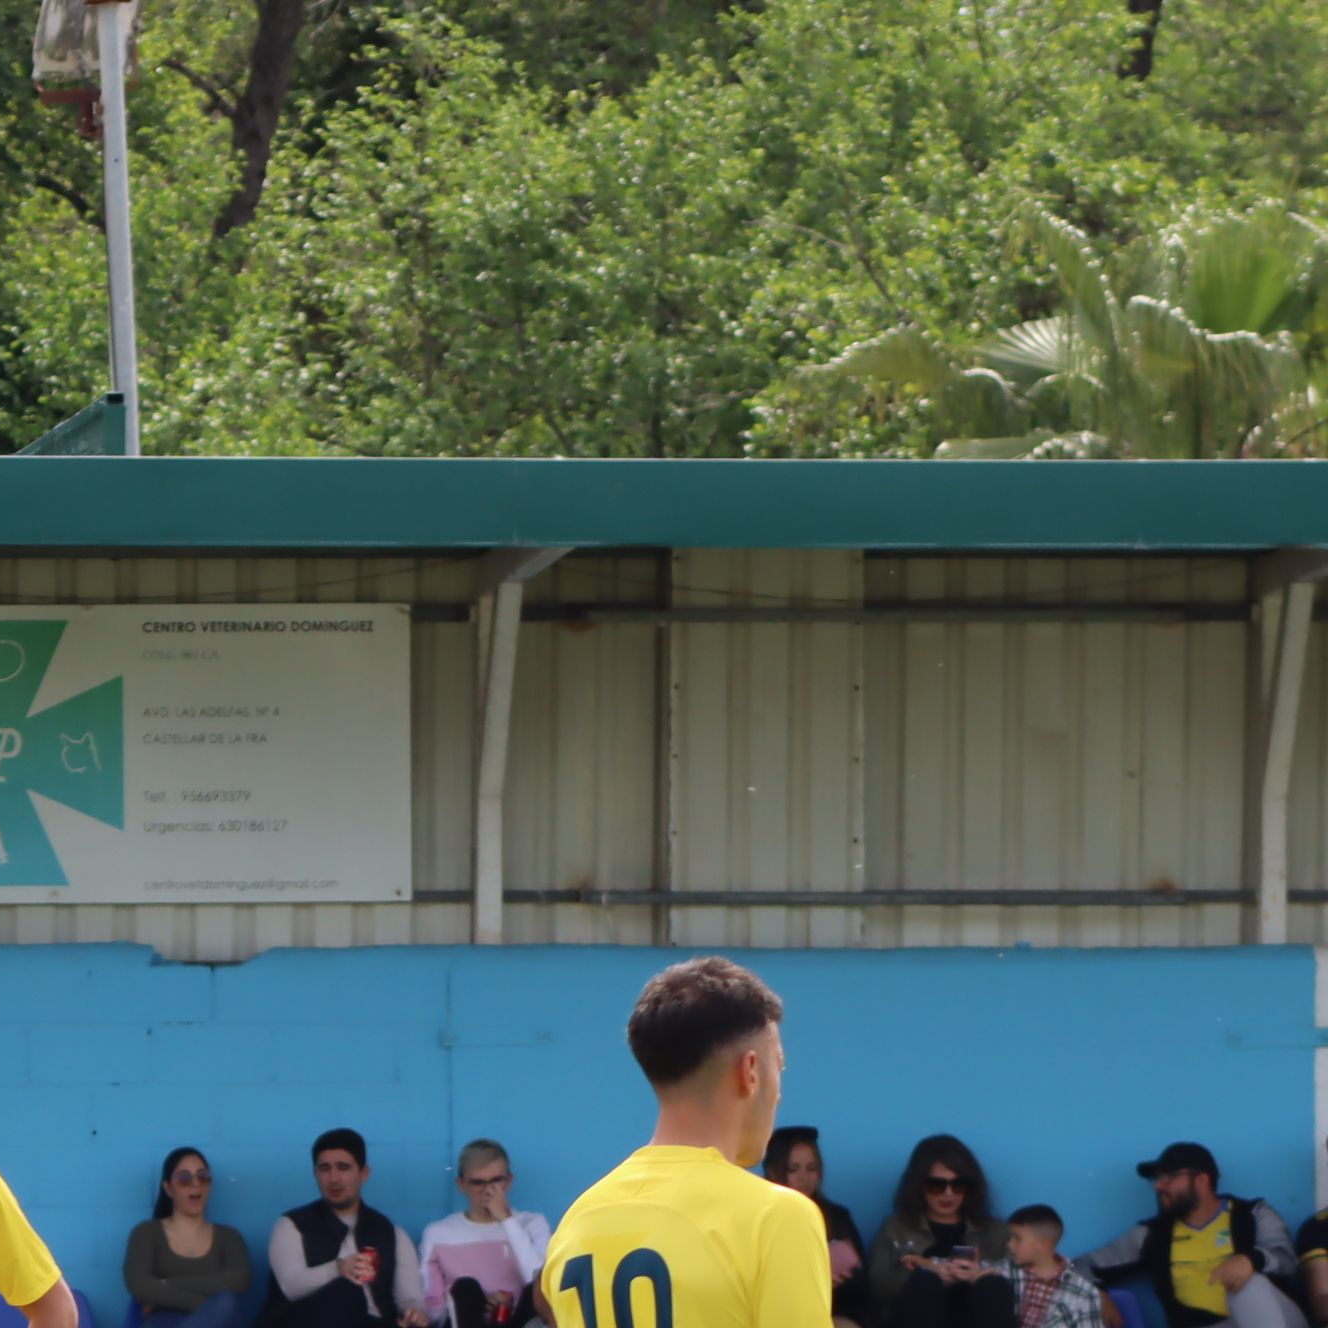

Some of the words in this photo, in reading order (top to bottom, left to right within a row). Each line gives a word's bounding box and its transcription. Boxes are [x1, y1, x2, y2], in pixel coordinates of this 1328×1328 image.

[141, 621, 196, 633] CENTRO
[200, 621, 286, 633] VETERINARIO
[290, 620, 374, 632] DOMINGUEZ
[142, 733, 206, 745] CASTELLAR
[208, 733, 225, 745] DE
[228, 733, 242, 745] LA
